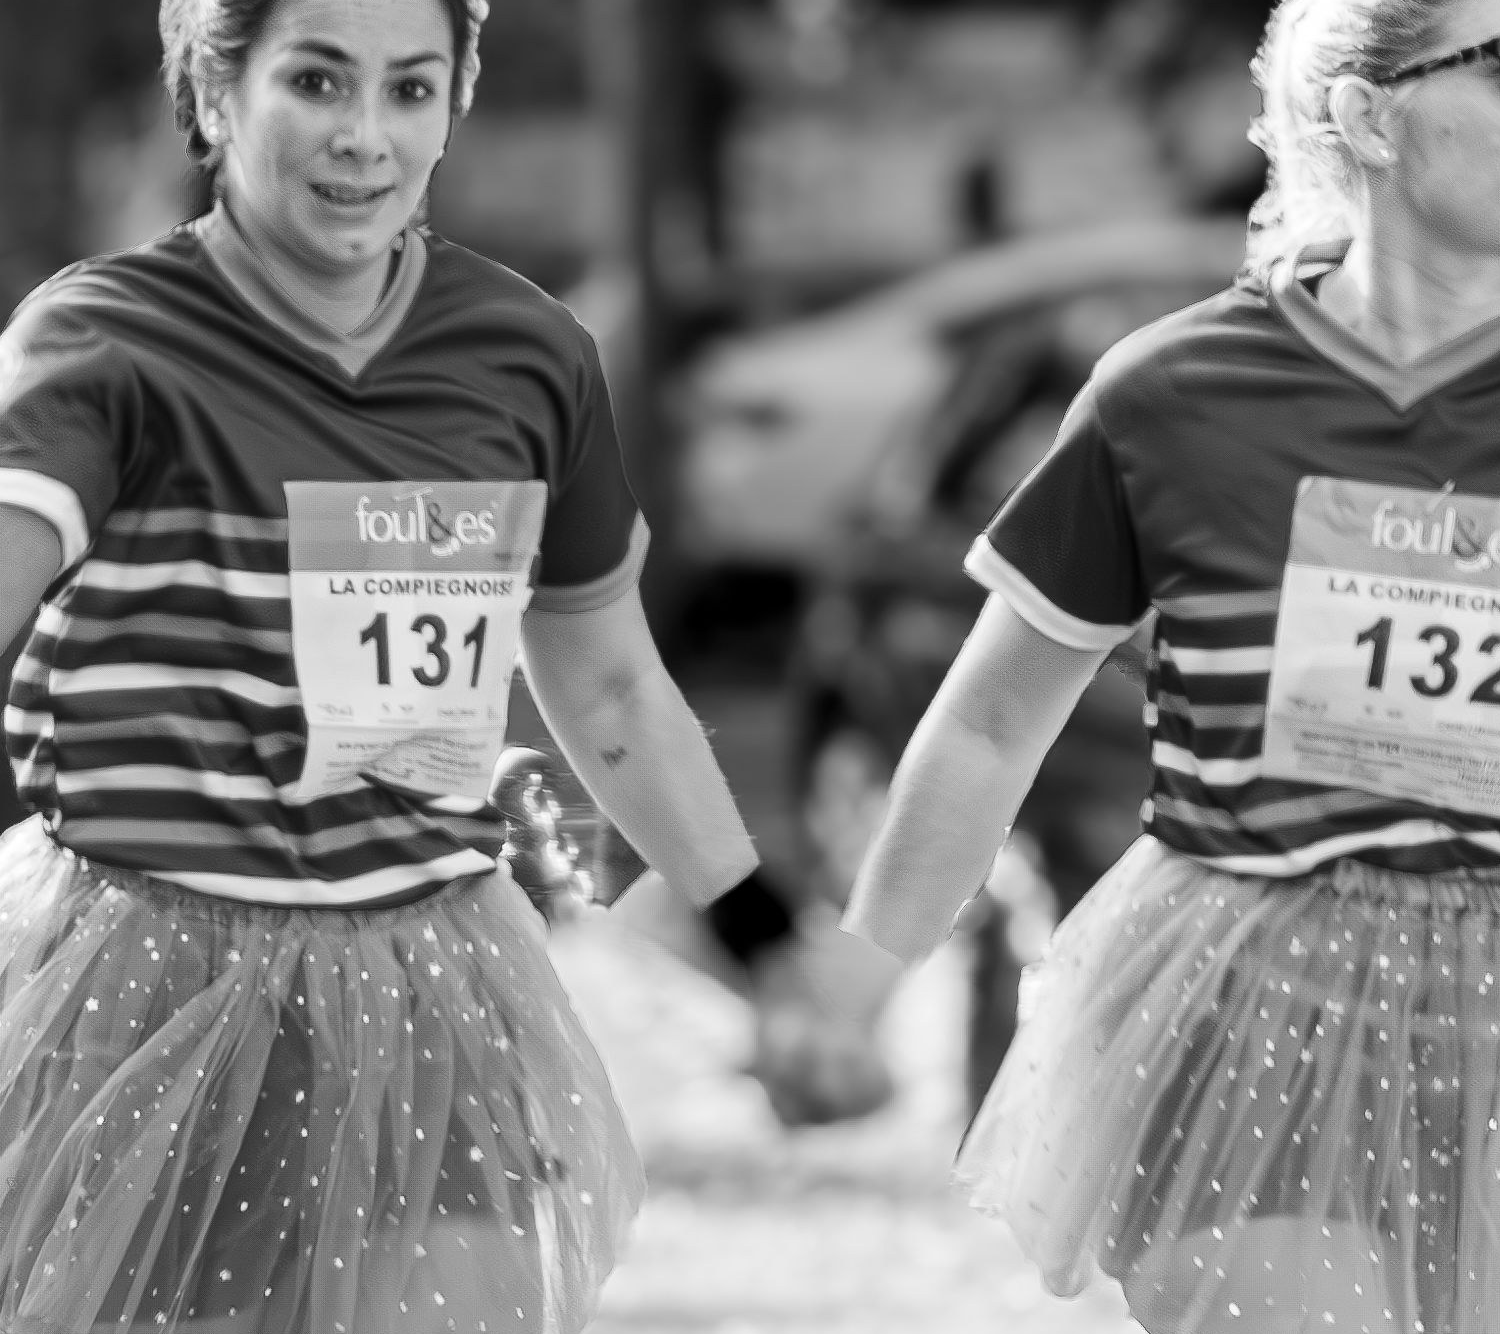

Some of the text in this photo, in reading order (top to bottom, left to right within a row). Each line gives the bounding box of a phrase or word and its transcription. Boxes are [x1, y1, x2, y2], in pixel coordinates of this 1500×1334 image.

[330, 578, 512, 596] LA COMPIEGNOIS
[1328, 576, 1359, 596] LA
[360, 612, 488, 688] 131
